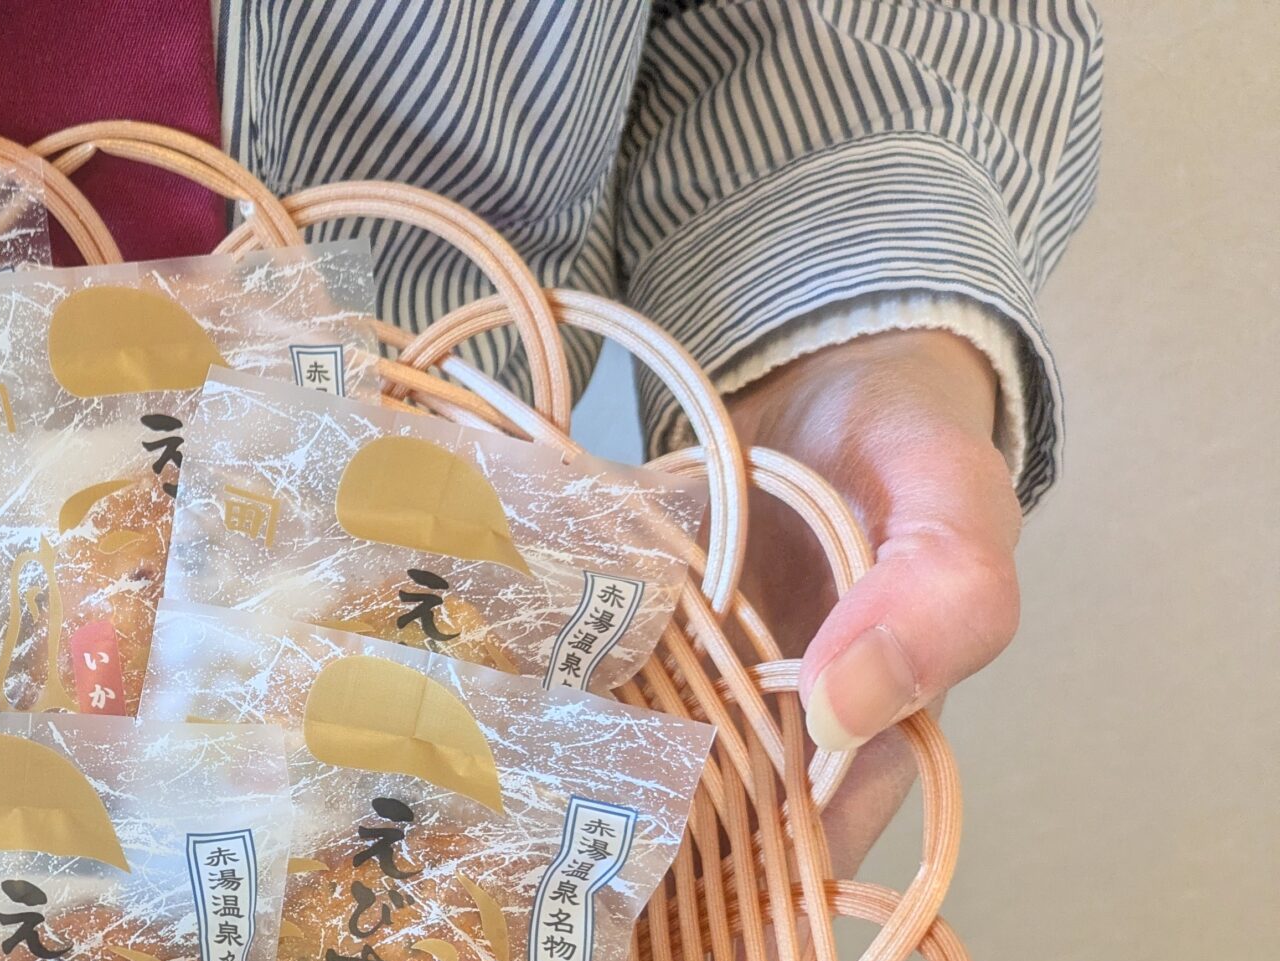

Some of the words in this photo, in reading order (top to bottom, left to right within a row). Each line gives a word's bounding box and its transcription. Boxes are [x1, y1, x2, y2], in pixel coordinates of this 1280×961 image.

[397, 569, 461, 650] え
[558, 584, 625, 688] 赤湯温泉
[83, 651, 116, 709] いか
[542, 817, 616, 961] 赤湯温泉名物
